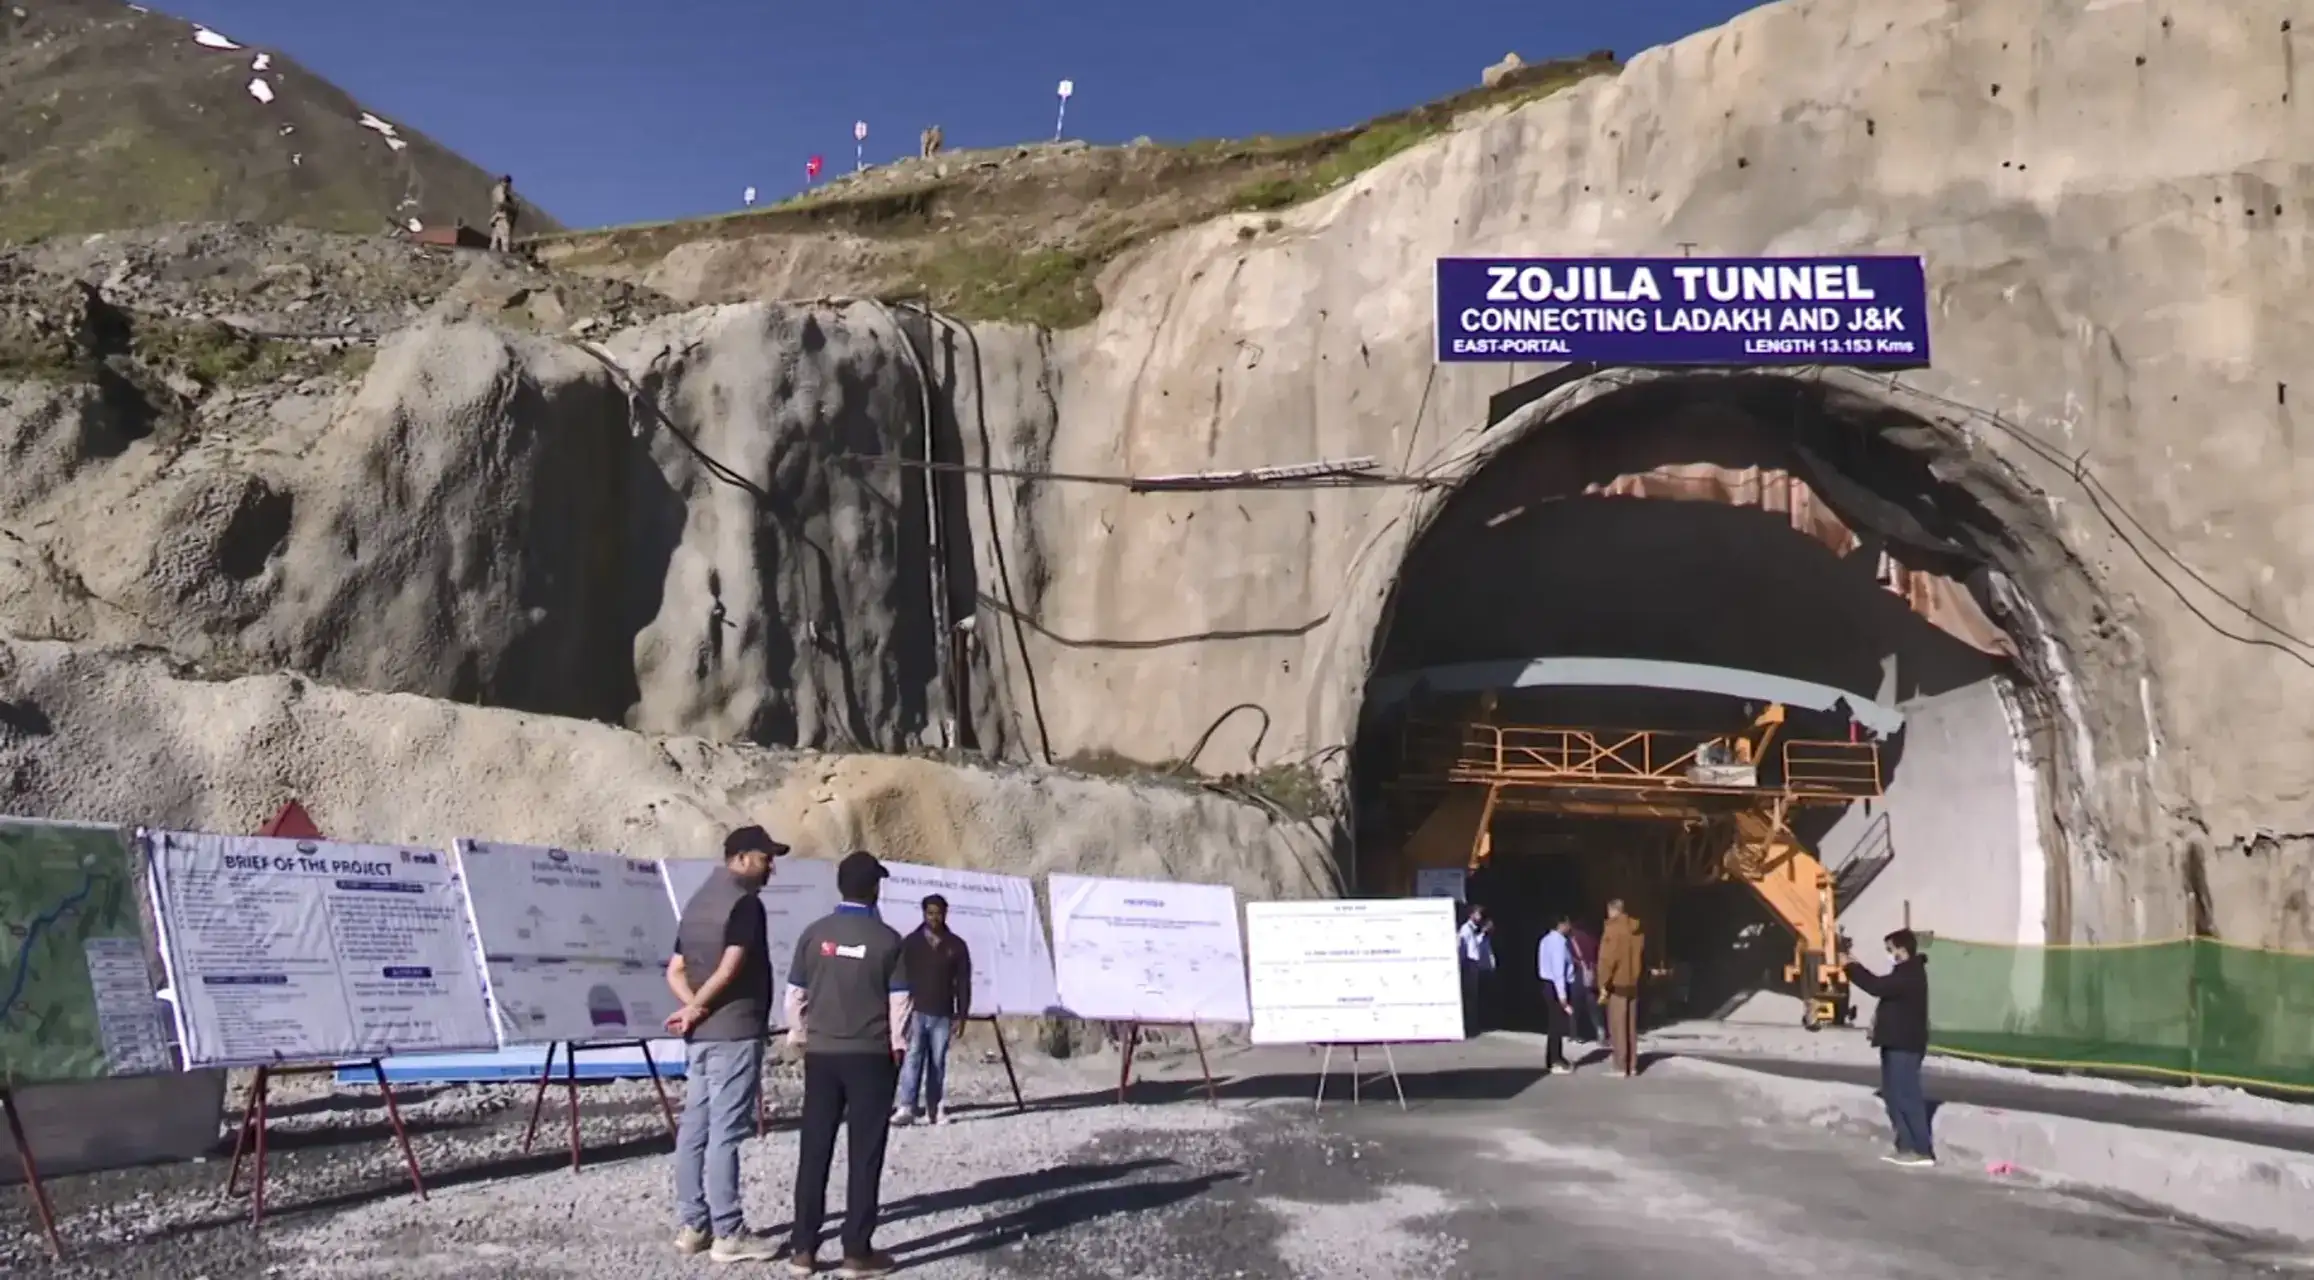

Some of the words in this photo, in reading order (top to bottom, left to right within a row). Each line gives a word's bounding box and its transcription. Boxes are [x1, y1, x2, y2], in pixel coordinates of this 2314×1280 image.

[1486, 266, 1662, 302] ZOJILA
[1673, 265, 1875, 301] TUNNEL
[1460, 307, 1647, 333] CONNECTING
[1654, 307, 1772, 332] LADAKH
[1778, 307, 1840, 332] AND
[1847, 306, 1905, 332] J&K
[1453, 338, 1571, 353] EAST-PORTAL
[1745, 338, 1816, 353] LENGTH
[1820, 338, 1873, 353] 13.153
[1876, 338, 1914, 353] Kms
[224, 854, 268, 871] BRIEF
[273, 859, 294, 872] OF
[298, 857, 328, 873] THE
[332, 860, 393, 877] PROJECT
